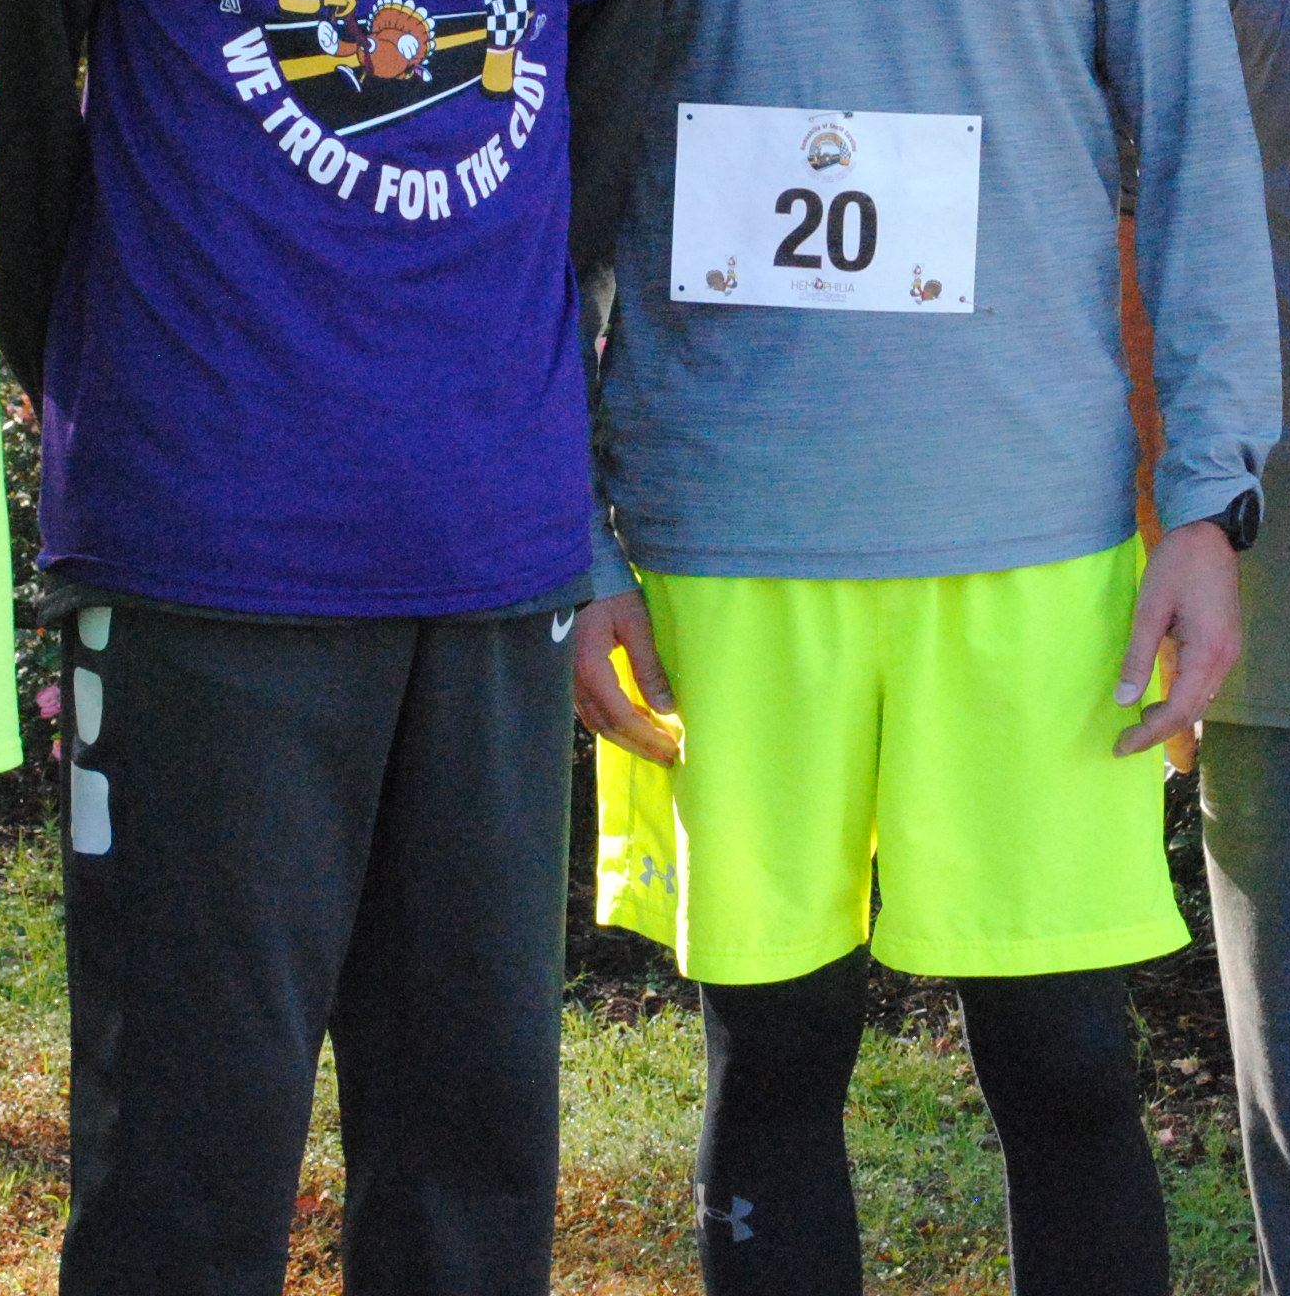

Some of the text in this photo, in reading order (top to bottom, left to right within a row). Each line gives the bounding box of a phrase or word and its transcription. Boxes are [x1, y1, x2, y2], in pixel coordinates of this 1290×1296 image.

[222, 26, 547, 221] WE TROT FOR THE CLOT
[773, 187, 878, 272] 20
